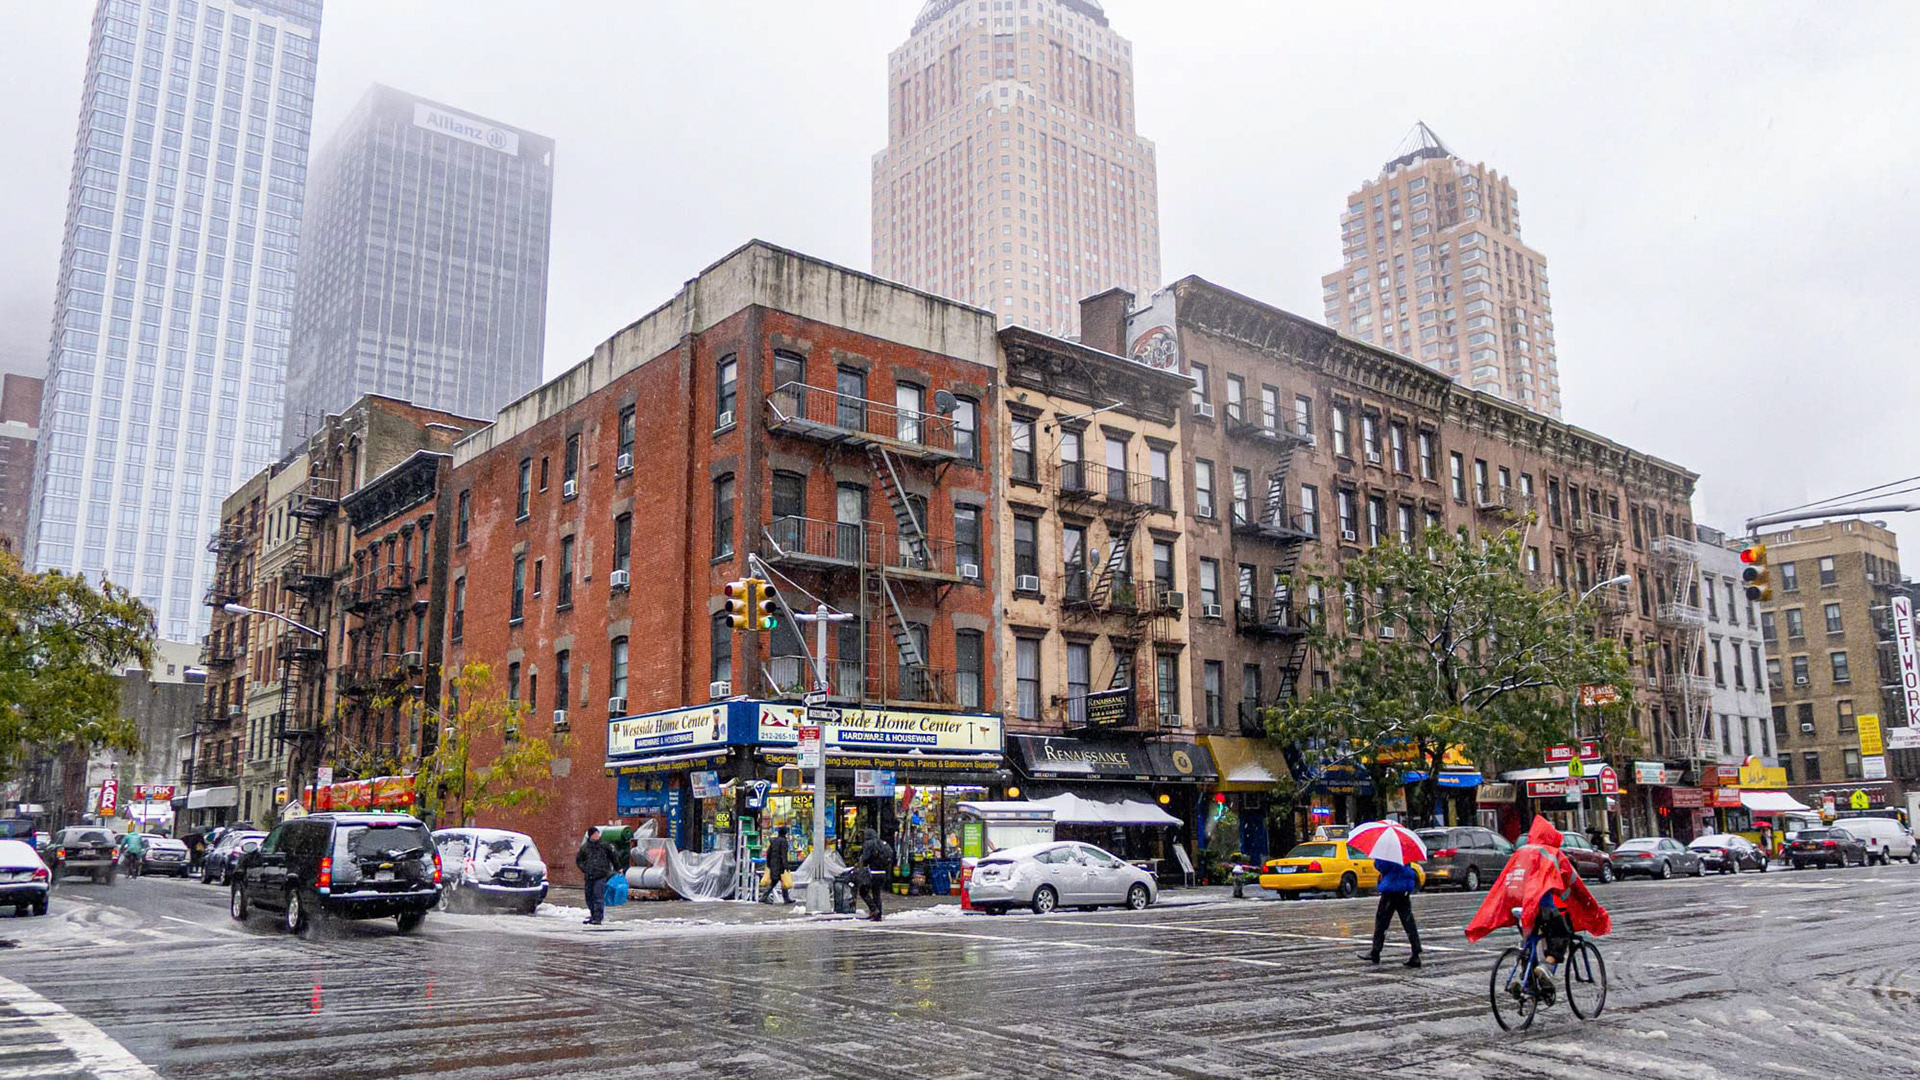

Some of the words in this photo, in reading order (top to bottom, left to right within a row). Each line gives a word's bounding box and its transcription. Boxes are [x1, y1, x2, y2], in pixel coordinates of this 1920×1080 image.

[426, 111, 483, 140] Allianz
[1895, 600, 1920, 725] NETWORK
[622, 720, 654, 738] Westside
[655, 719, 679, 733] Home
[681, 714, 711, 730] Center
[874, 714, 915, 731] Home
[919, 716, 962, 733] Center
[636, 737, 660, 748] HARDWARE
[664, 733, 693, 744] HOUSEWARE
[761, 732, 799, 740] 212-265-101
[842, 732, 885, 742] HARDWARE
[885, 734, 891, 742] &
[892, 735, 936, 743] HOUSEWARE
[766, 754, 798, 764] Electrica
[825, 757, 840, 767] bing
[875, 758, 895, 767] Power
[917, 760, 937, 768] Paints
[938, 760, 943, 768] &
[945, 760, 973, 768] Bathroom
[974, 760, 999, 769] Supplies
[1044, 745, 1129, 763] RENAISSANCE
[101, 780, 116, 808] PARK
[140, 786, 171, 794] PRK
[1535, 781, 1567, 794] McCoy
